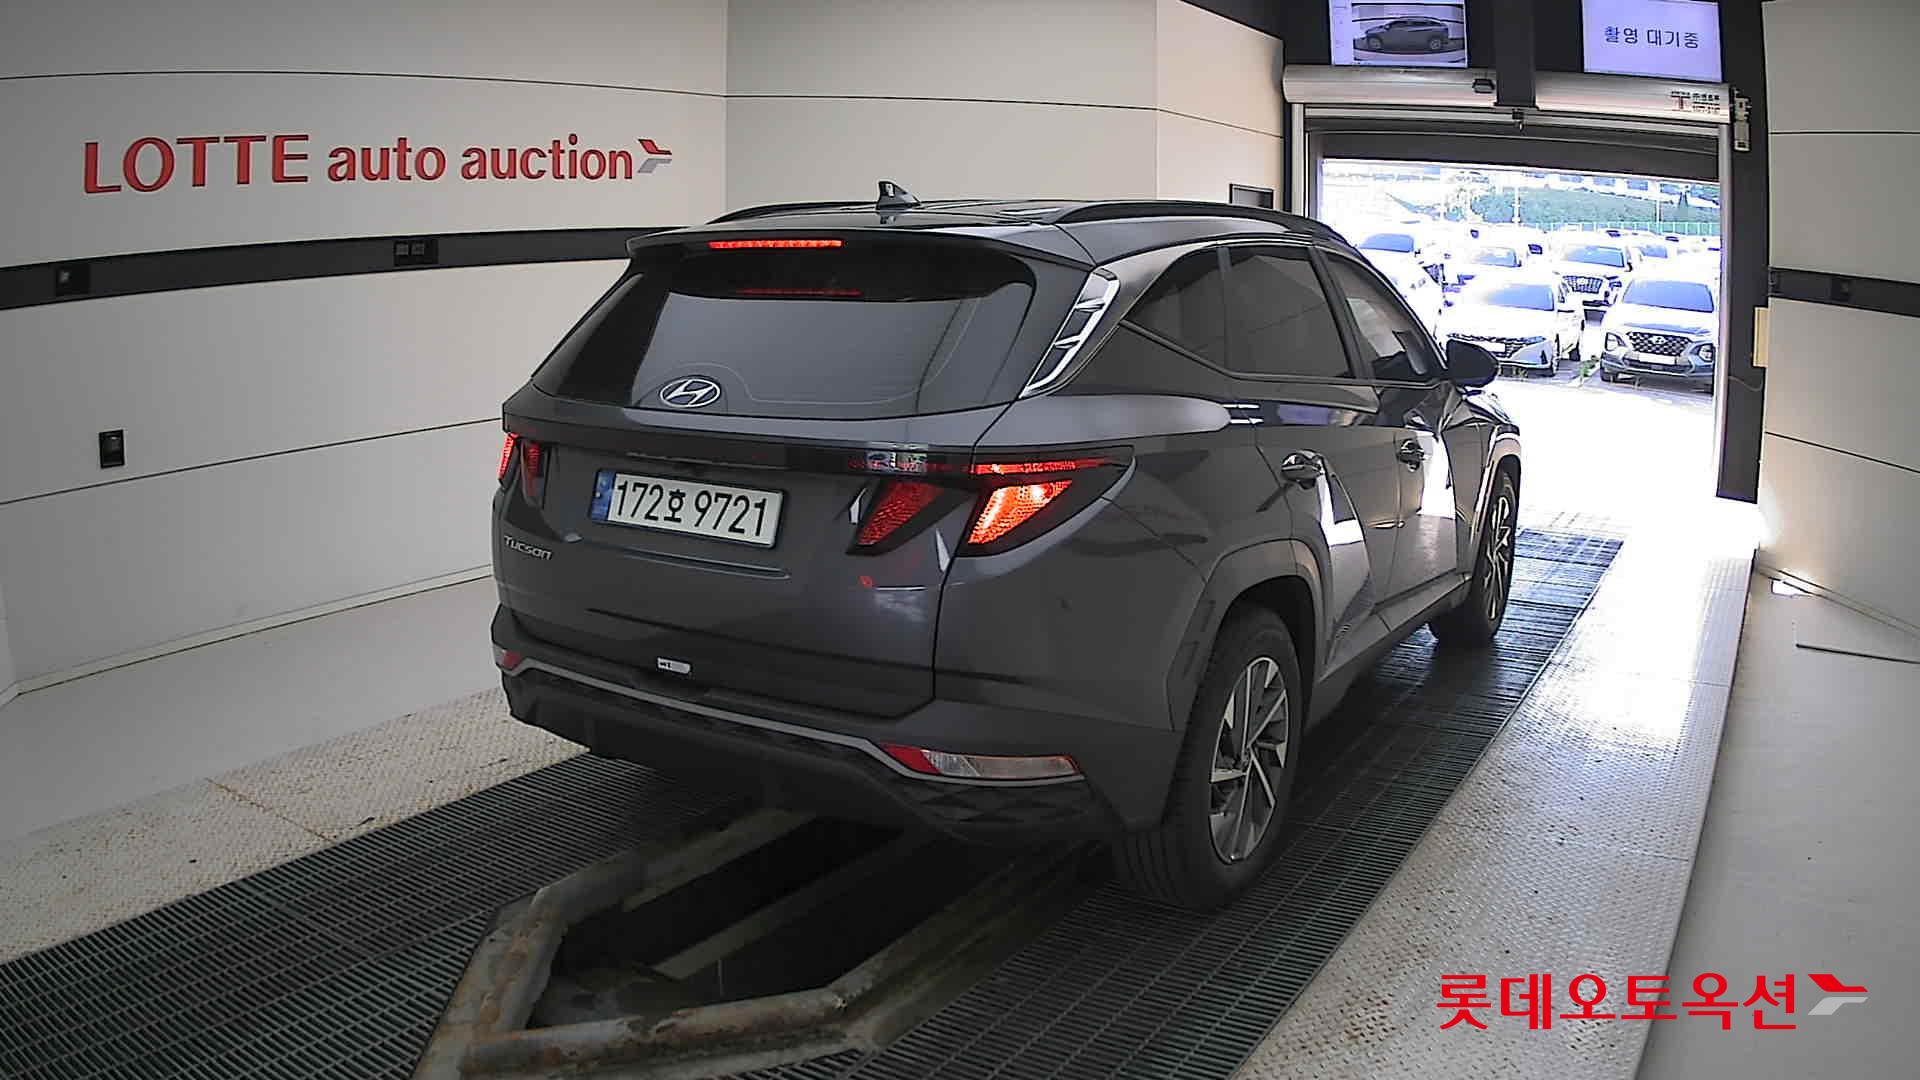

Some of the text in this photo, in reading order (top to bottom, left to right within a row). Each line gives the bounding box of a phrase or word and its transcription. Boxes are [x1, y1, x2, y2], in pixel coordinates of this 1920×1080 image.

[1605, 26, 1699, 49] 촬영 대기중
[84, 133, 633, 194] LOTTE auto auction
[616, 480, 768, 537] 172호 9721
